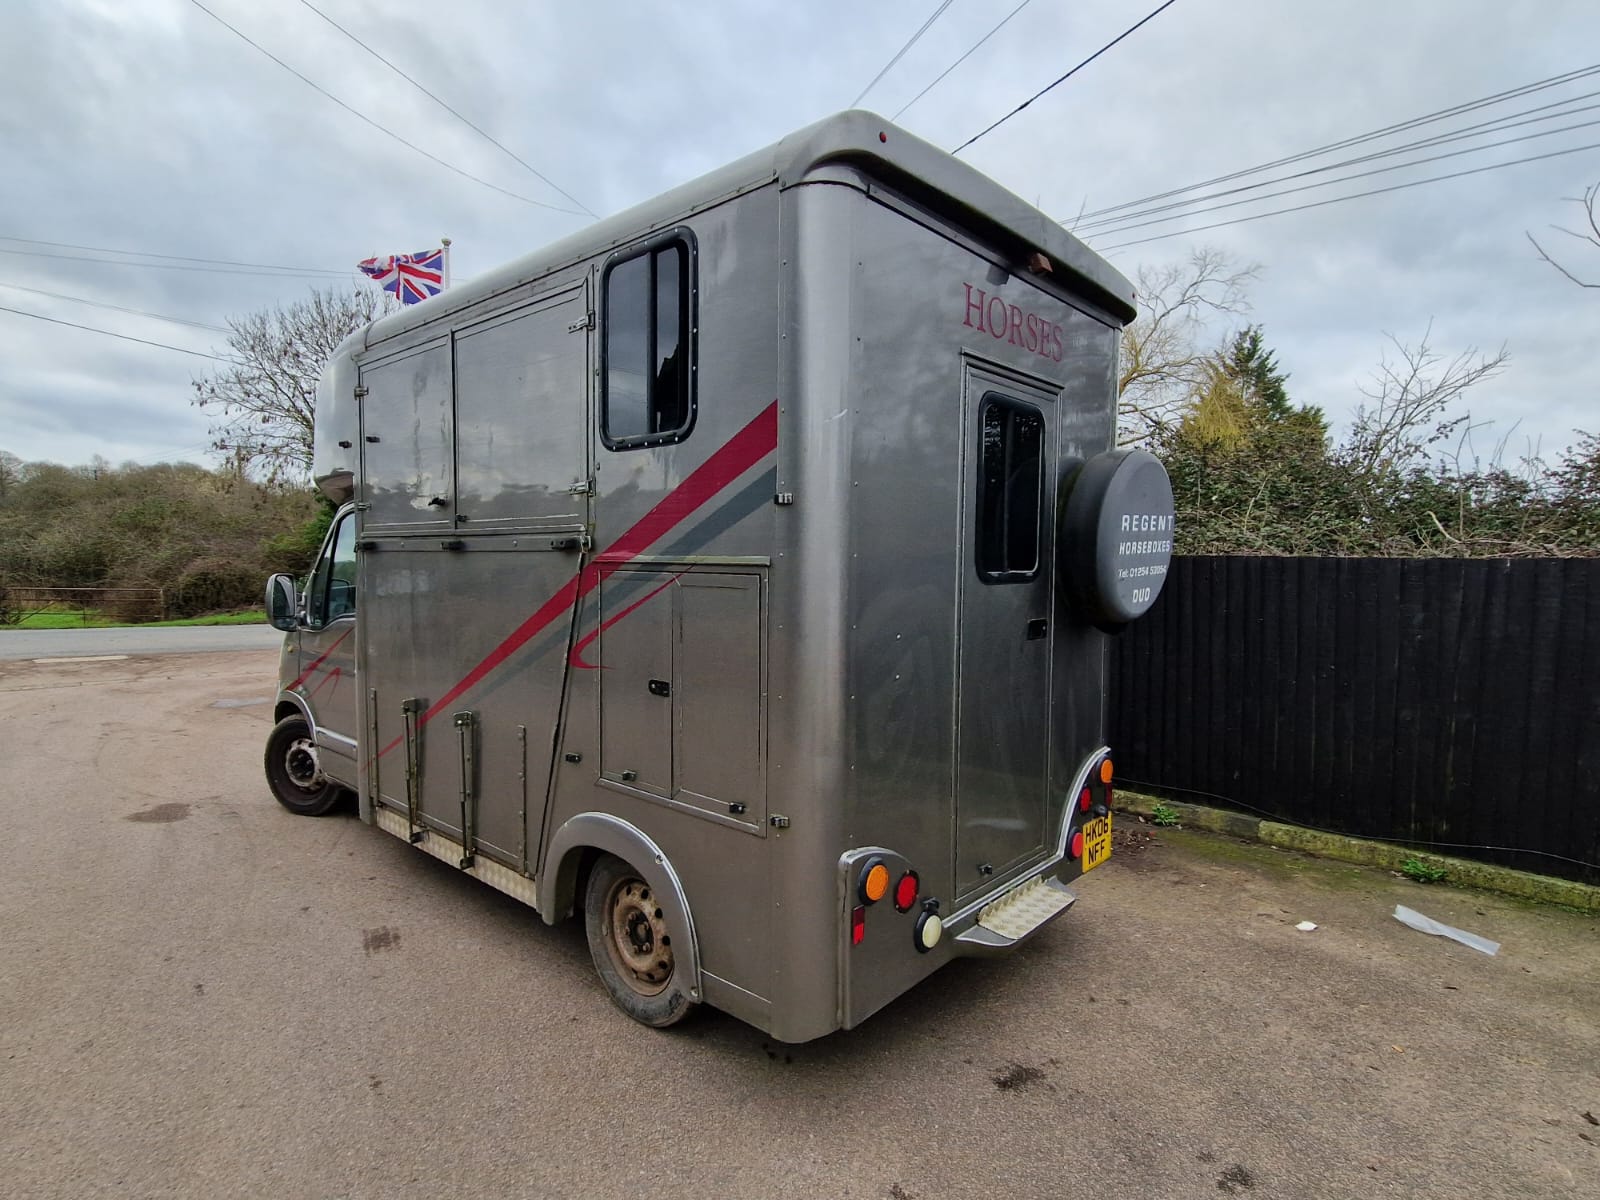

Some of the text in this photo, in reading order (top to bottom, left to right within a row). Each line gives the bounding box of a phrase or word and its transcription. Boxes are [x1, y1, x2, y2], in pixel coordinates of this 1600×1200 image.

[962, 282, 1063, 362] HORSES
[1121, 514, 1174, 532] REGENT
[1119, 540, 1171, 555] HORSEBOXES
[1132, 587, 1151, 603] DUO
[1085, 818, 1109, 844] HK06
[1088, 838, 1106, 865] NFF
